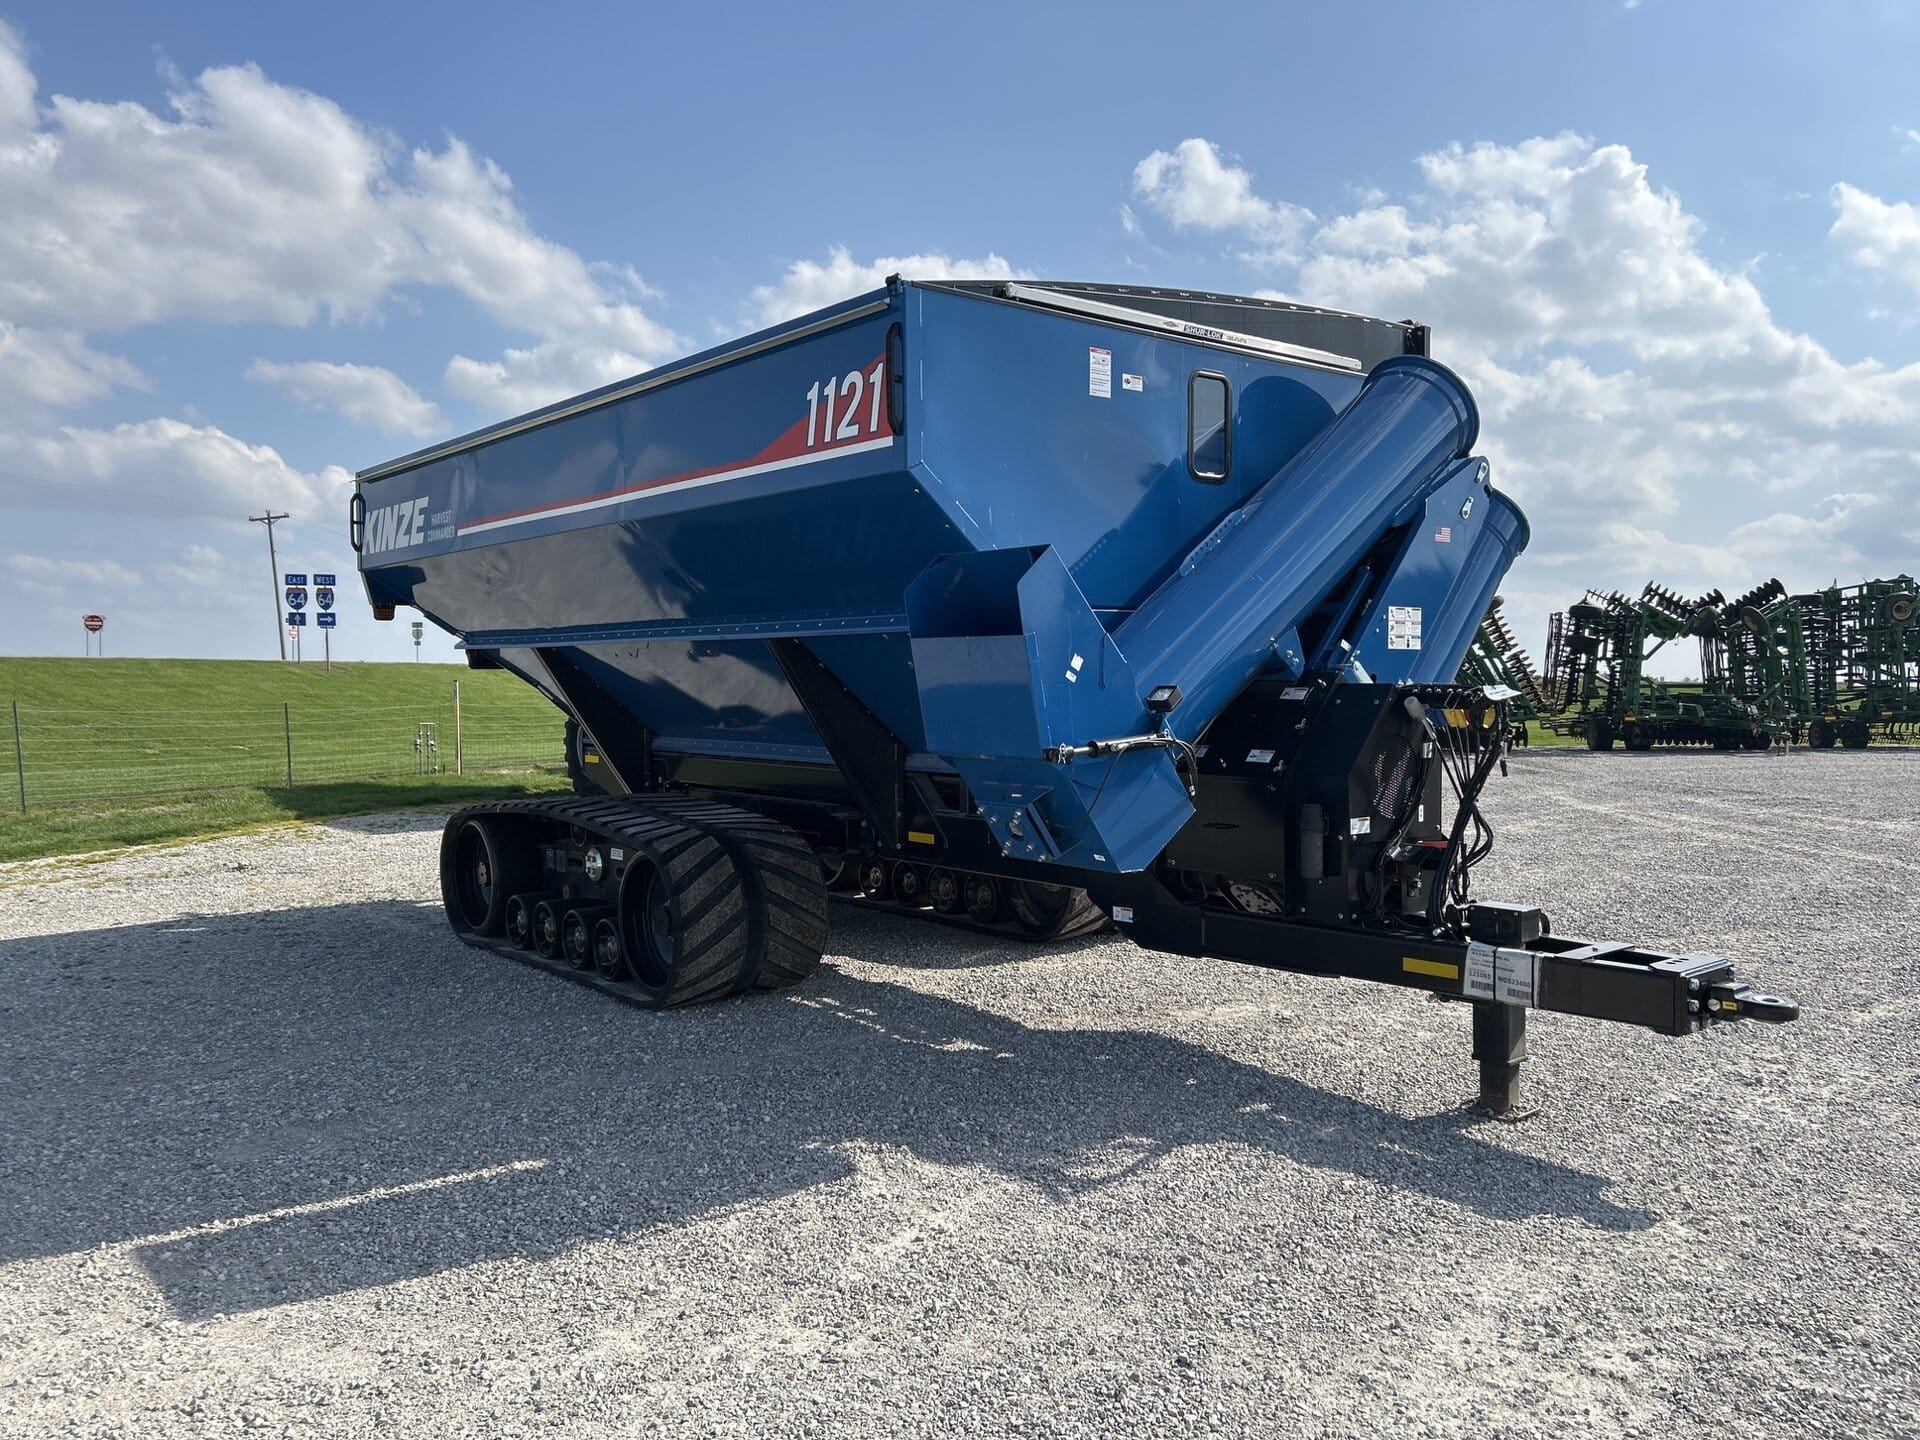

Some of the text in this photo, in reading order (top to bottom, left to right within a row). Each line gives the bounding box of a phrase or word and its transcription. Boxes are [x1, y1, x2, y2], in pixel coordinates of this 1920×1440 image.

[1185, 324, 1223, 339] SHUR-LOK
[806, 362, 884, 447] 1121
[430, 510, 452, 525] HARVEST
[362, 496, 430, 555] KINZE
[427, 525, 455, 543] COMMANDER
[288, 576, 304, 584] EAST
[316, 576, 333, 584] WEST
[288, 593, 305, 606] 64
[318, 593, 332, 606] 64
